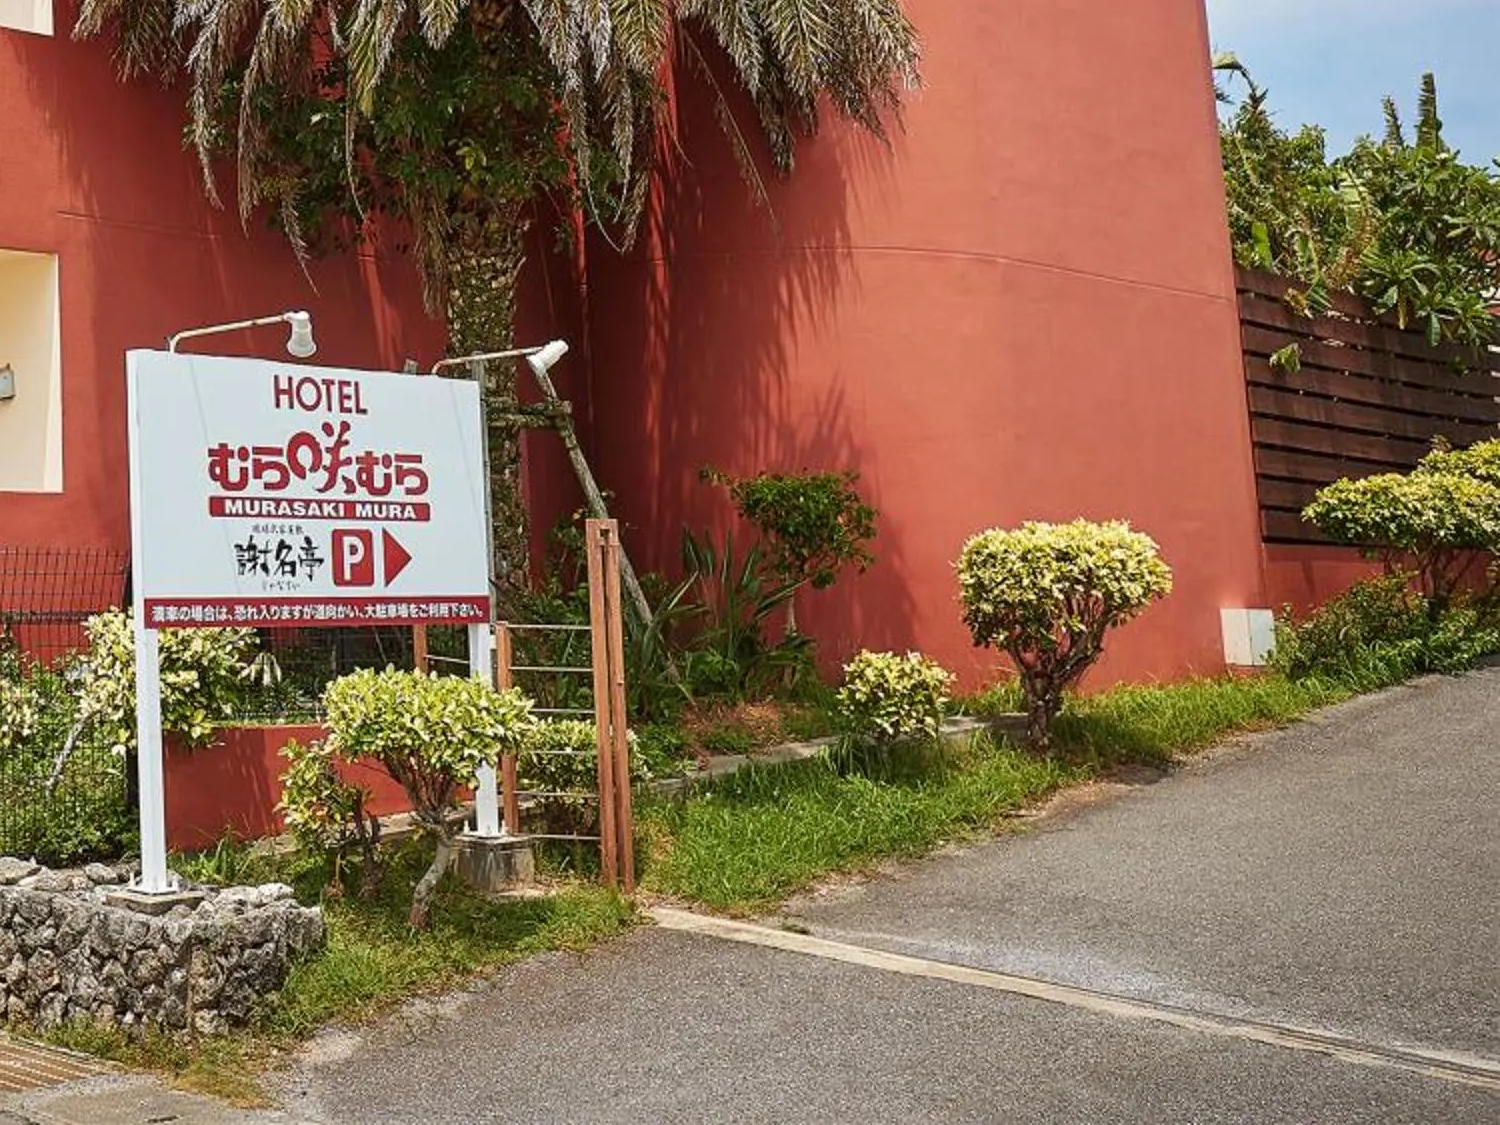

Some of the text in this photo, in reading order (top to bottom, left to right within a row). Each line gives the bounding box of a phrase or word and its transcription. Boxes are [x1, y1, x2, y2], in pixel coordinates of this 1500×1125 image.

[273, 375, 367, 414] HOTEL
[209, 420, 429, 496] むら咲むら
[224, 499, 416, 520] MURASAKI MURA
[342, 536, 366, 581] P
